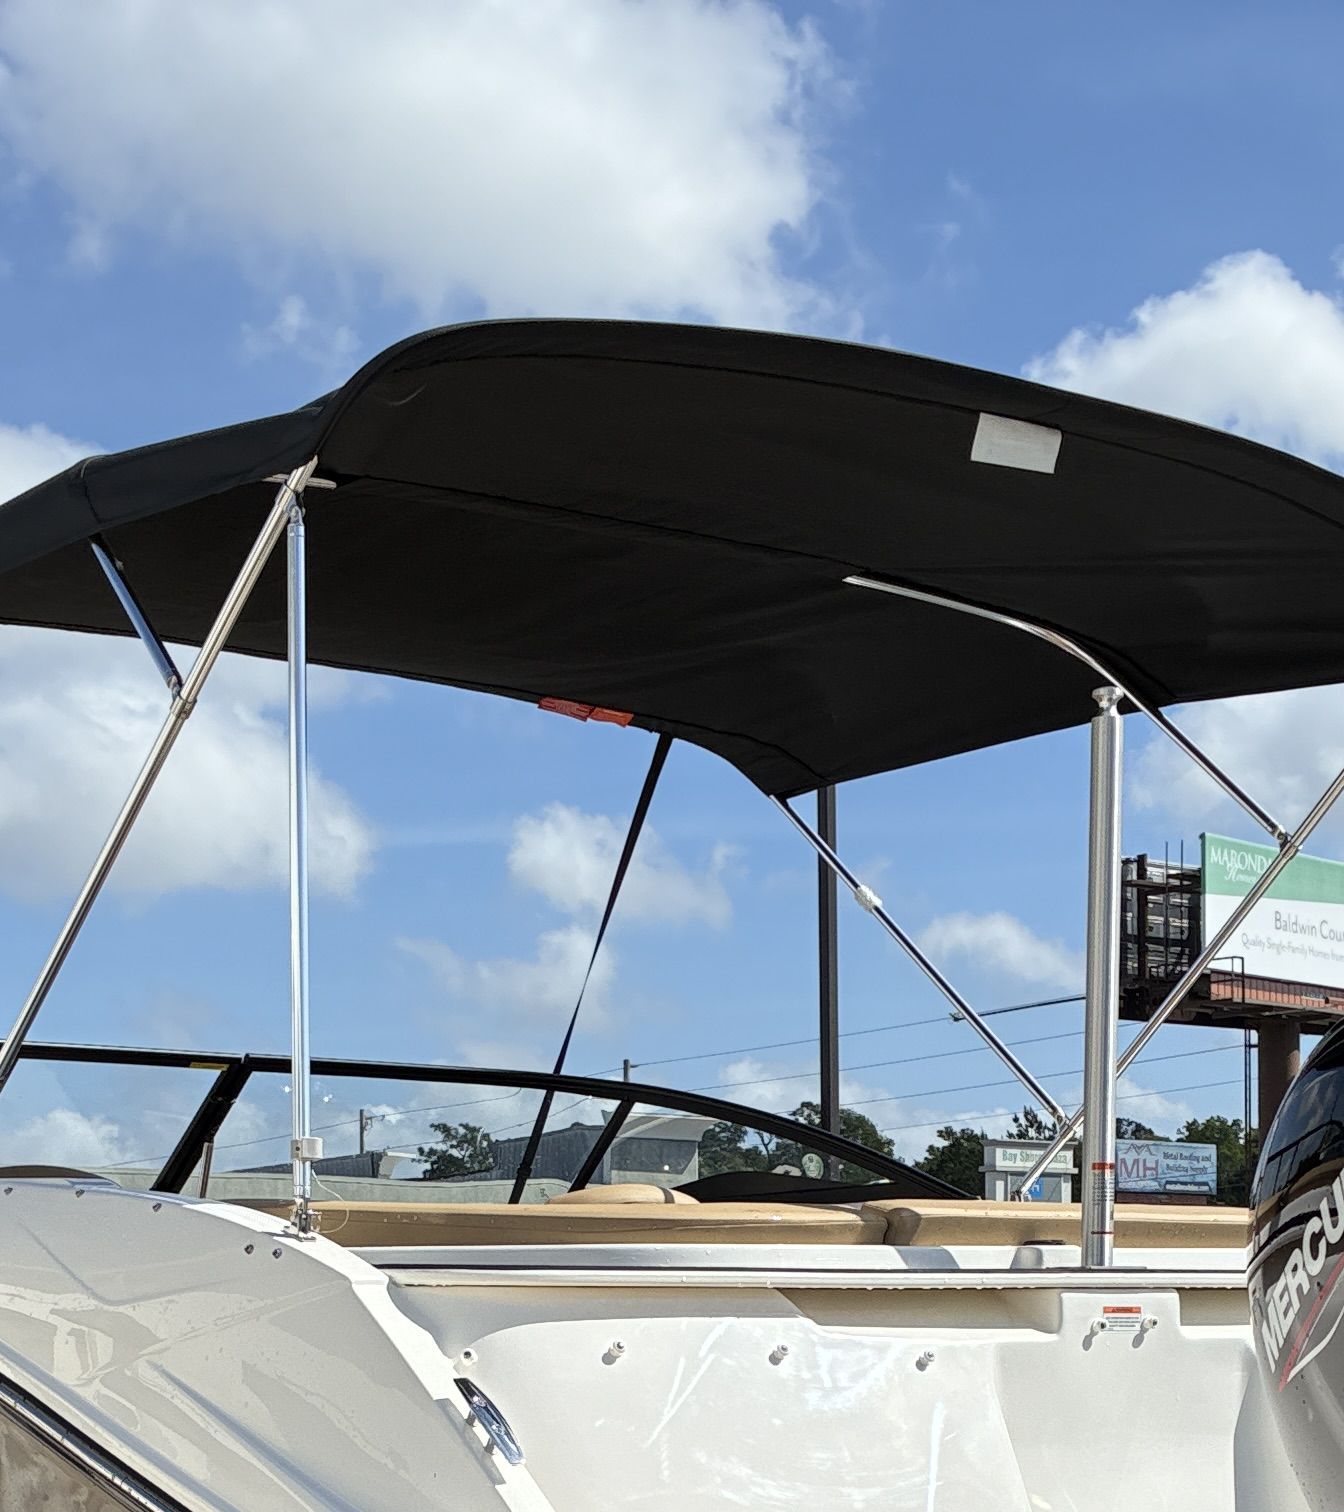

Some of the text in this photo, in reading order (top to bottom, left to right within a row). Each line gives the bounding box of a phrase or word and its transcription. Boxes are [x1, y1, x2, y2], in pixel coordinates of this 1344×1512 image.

[1210, 846, 1273, 874] MAROND
[1274, 910, 1317, 939] Baldwin
[1241, 932, 1265, 953] Quality
[1308, 945, 1330, 961] Homes
[1330, 947, 1344, 962] from
[1002, 1150, 1018, 1164] Bay
[1019, 1150, 1042, 1163] Shor
